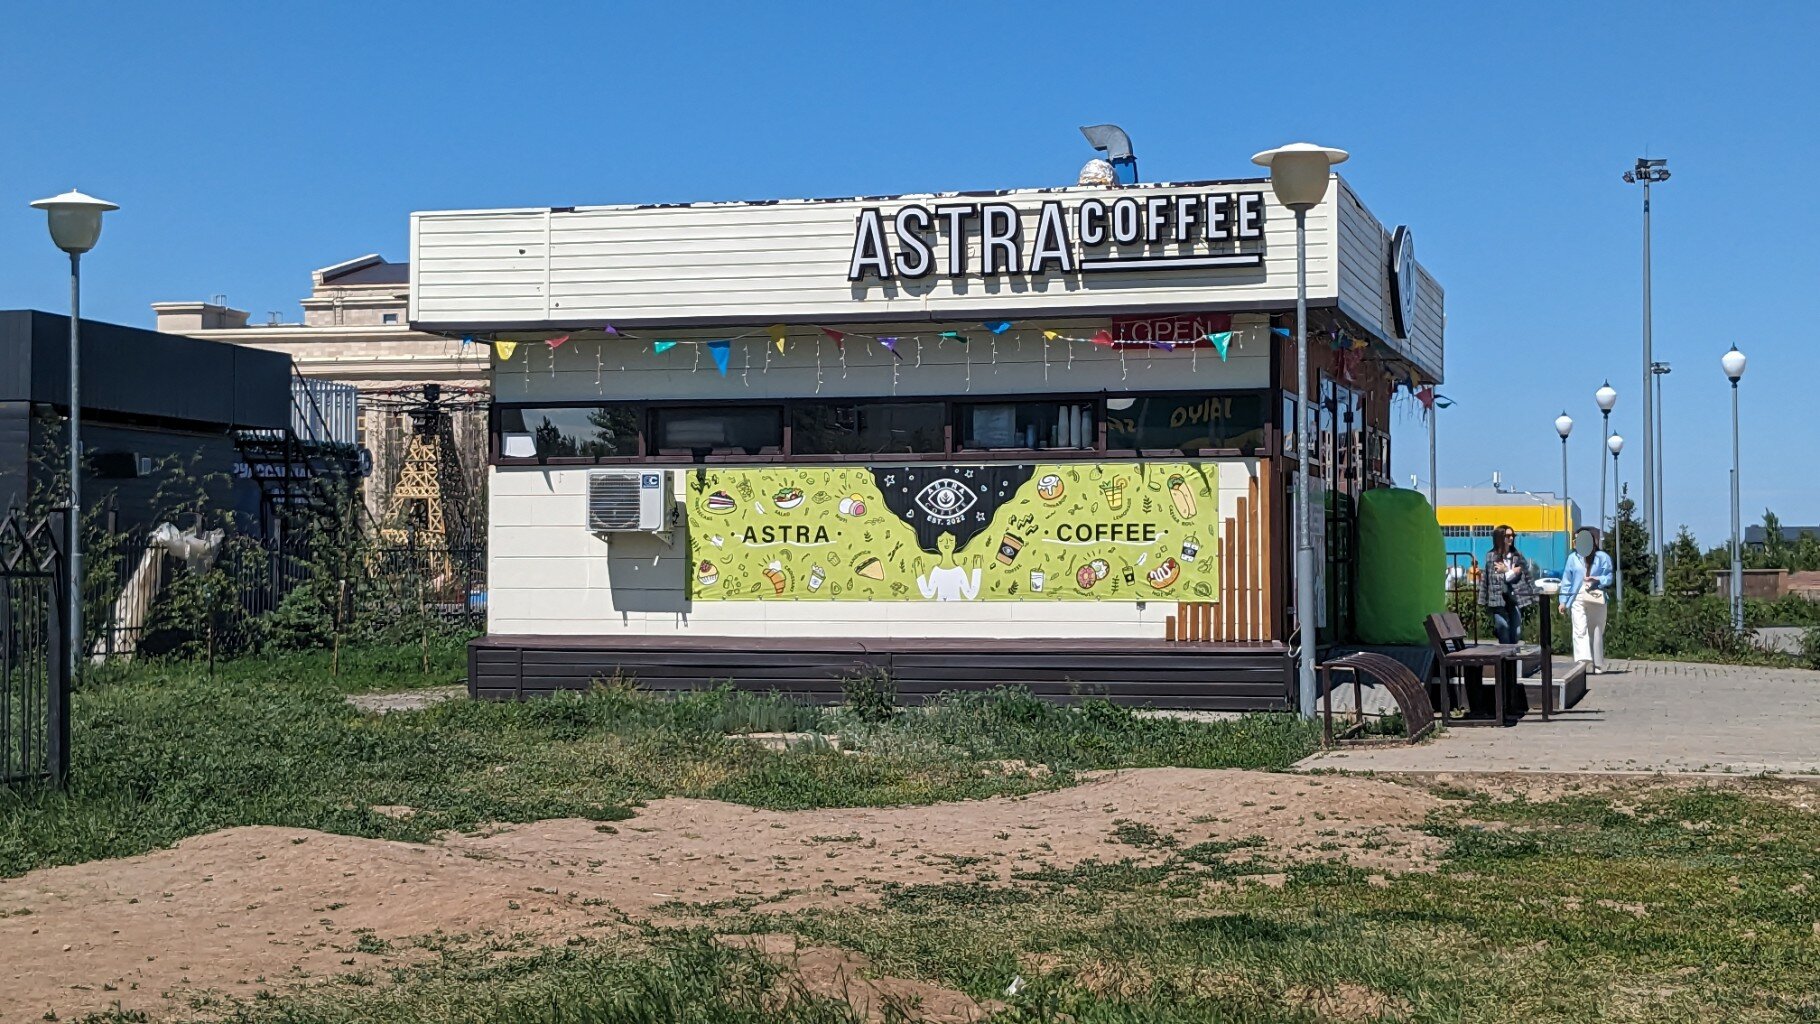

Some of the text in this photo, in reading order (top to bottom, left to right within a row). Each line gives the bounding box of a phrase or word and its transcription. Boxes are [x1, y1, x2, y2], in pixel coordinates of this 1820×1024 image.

[1079, 192, 1264, 246] COFFEE
[848, 200, 1074, 281] ASTRA
[1131, 321, 1212, 343] OPEN
[927, 480, 965, 495] ASTRA
[742, 525, 830, 543] ASTRA
[1056, 523, 1157, 542] COFFEE
